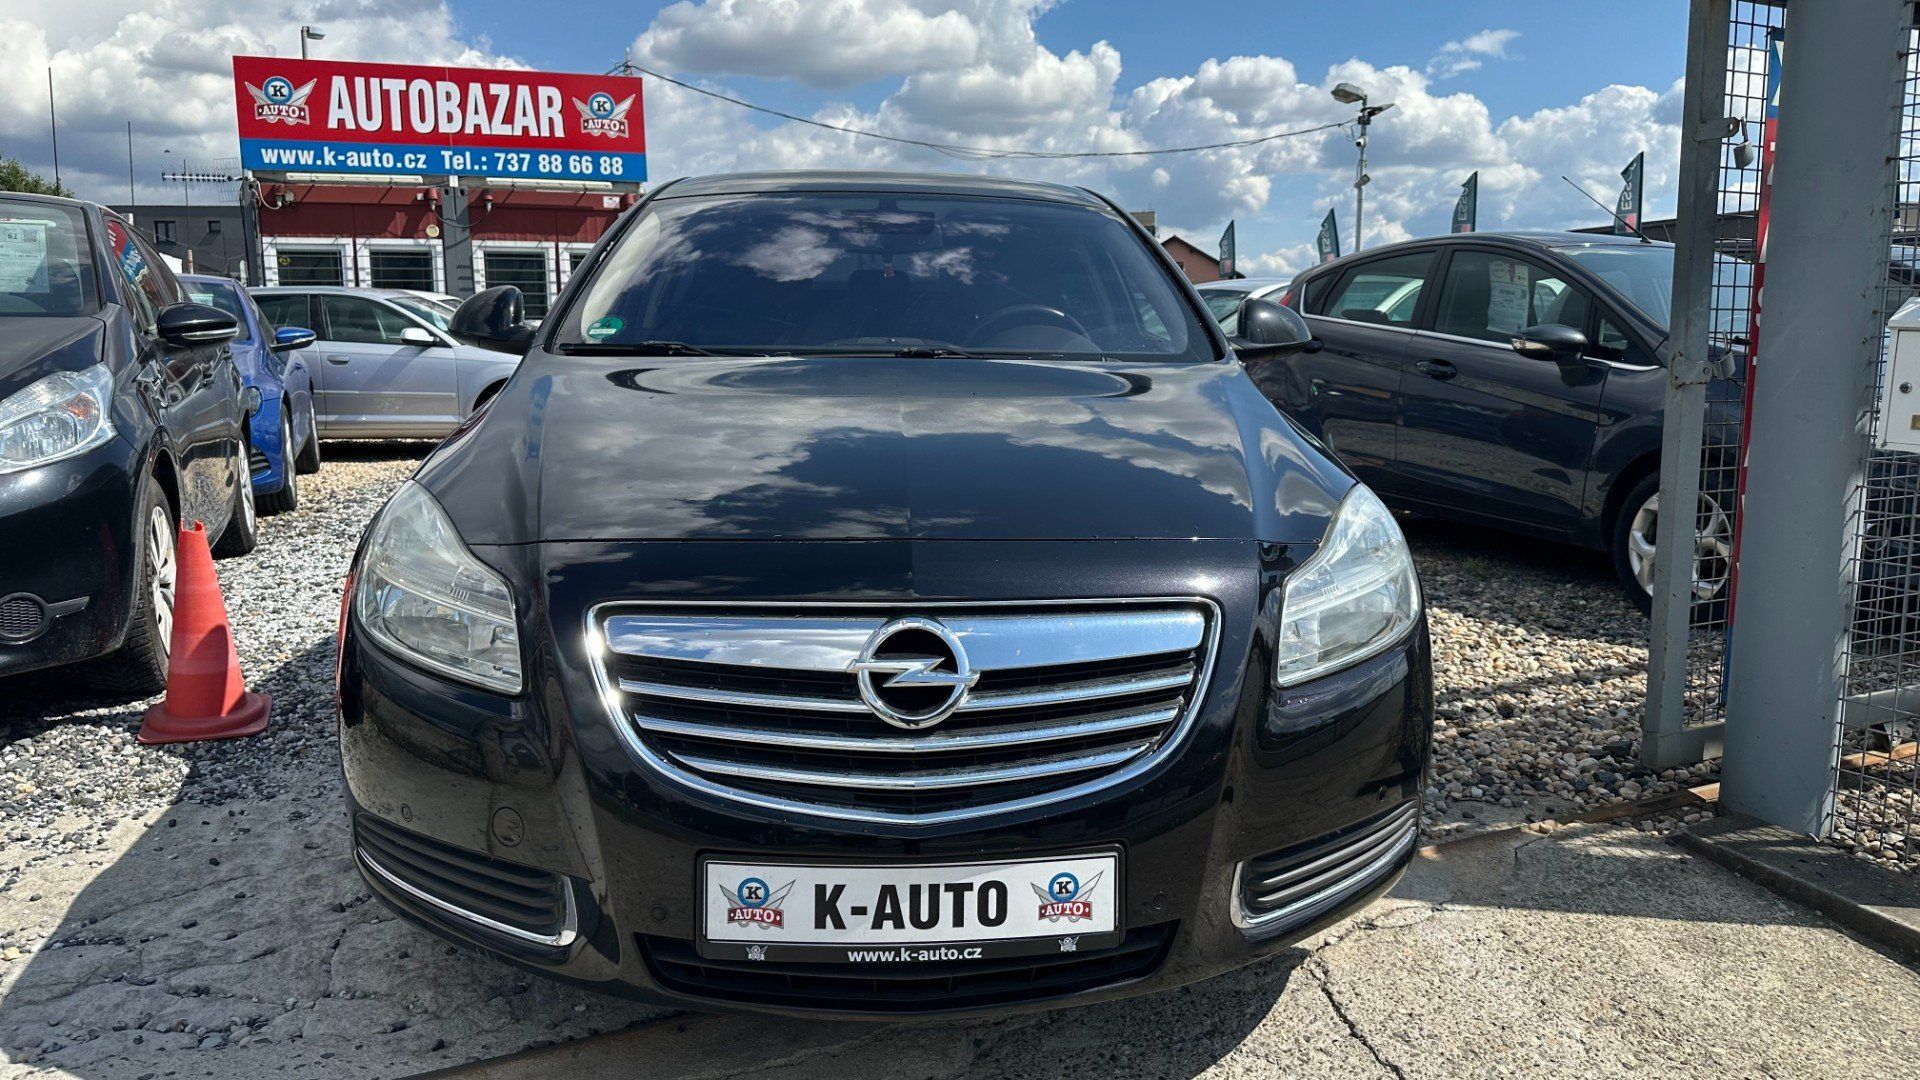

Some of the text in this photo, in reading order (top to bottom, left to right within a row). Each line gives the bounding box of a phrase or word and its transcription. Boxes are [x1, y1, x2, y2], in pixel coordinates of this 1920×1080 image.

[270, 85, 287, 98] K
[262, 105, 300, 118] AUTO
[327, 75, 565, 138] AUTOBAZAR
[595, 100, 609, 112] K
[587, 119, 620, 131] AUTO
[260, 146, 623, 175] www.k-auto.cz Tel.: 737 88 66 88
[745, 886, 762, 900] K
[1056, 880, 1072, 894] K
[814, 880, 1008, 930] K-AUTO
[1045, 902, 1084, 915] AUTO
[734, 908, 775, 922] AUTO
[847, 947, 982, 962] www.k-auto.cz
